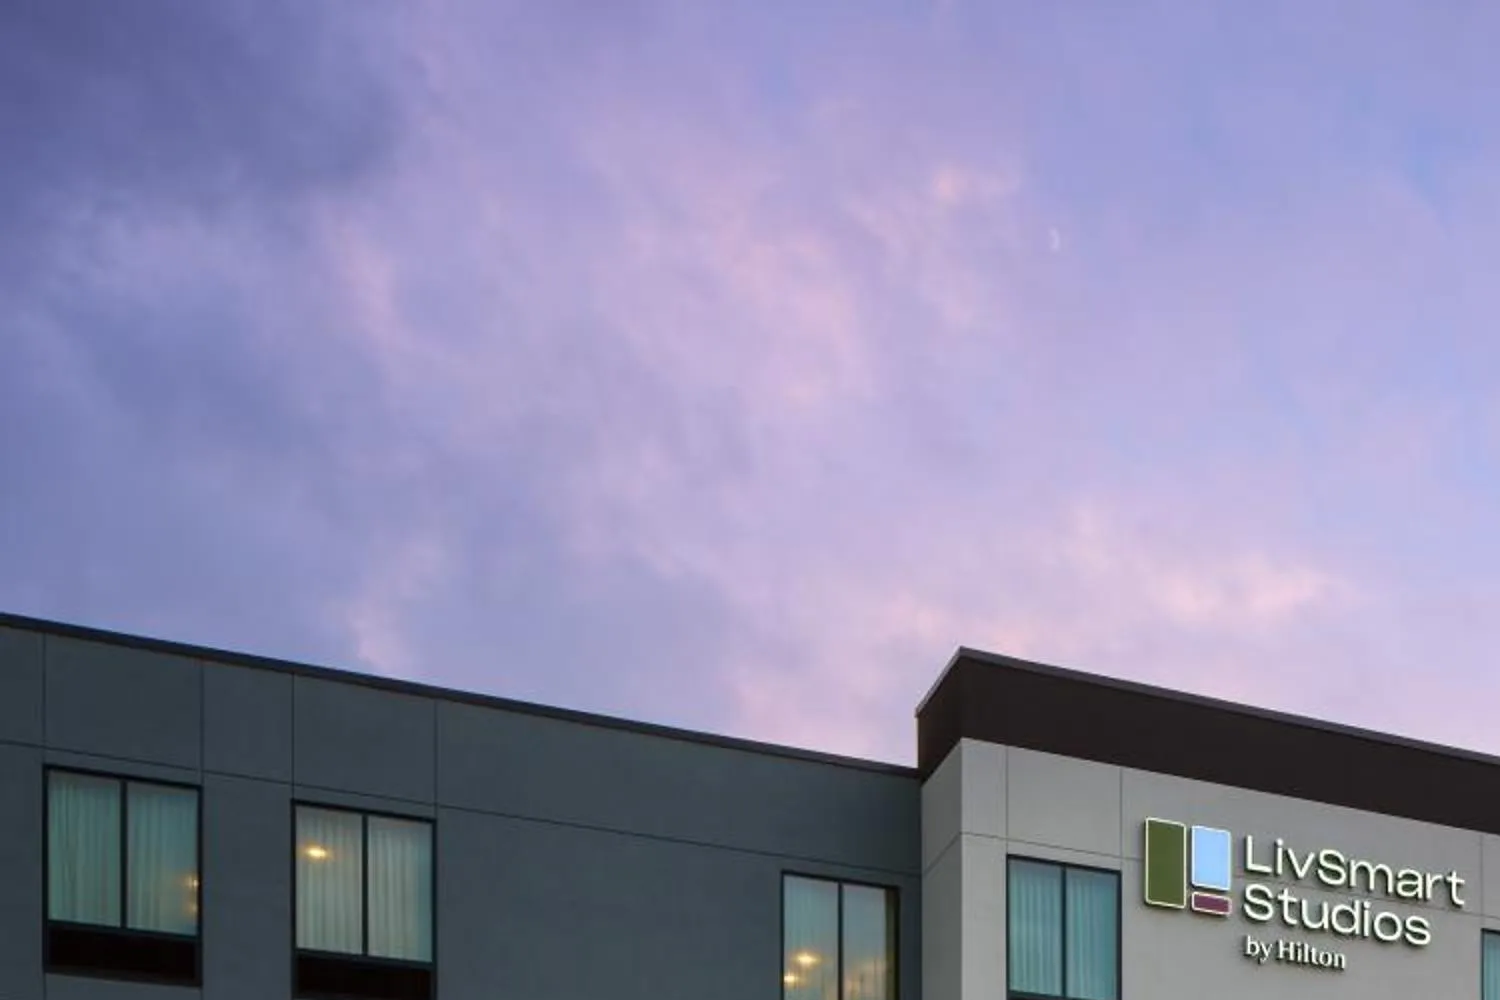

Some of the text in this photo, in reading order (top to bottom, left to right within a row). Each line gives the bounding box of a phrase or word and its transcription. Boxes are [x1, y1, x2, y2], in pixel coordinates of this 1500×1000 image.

[1244, 834, 1466, 907] LivSmart
[1243, 882, 1432, 946] Studios
[1245, 934, 1346, 969] by Hilton
